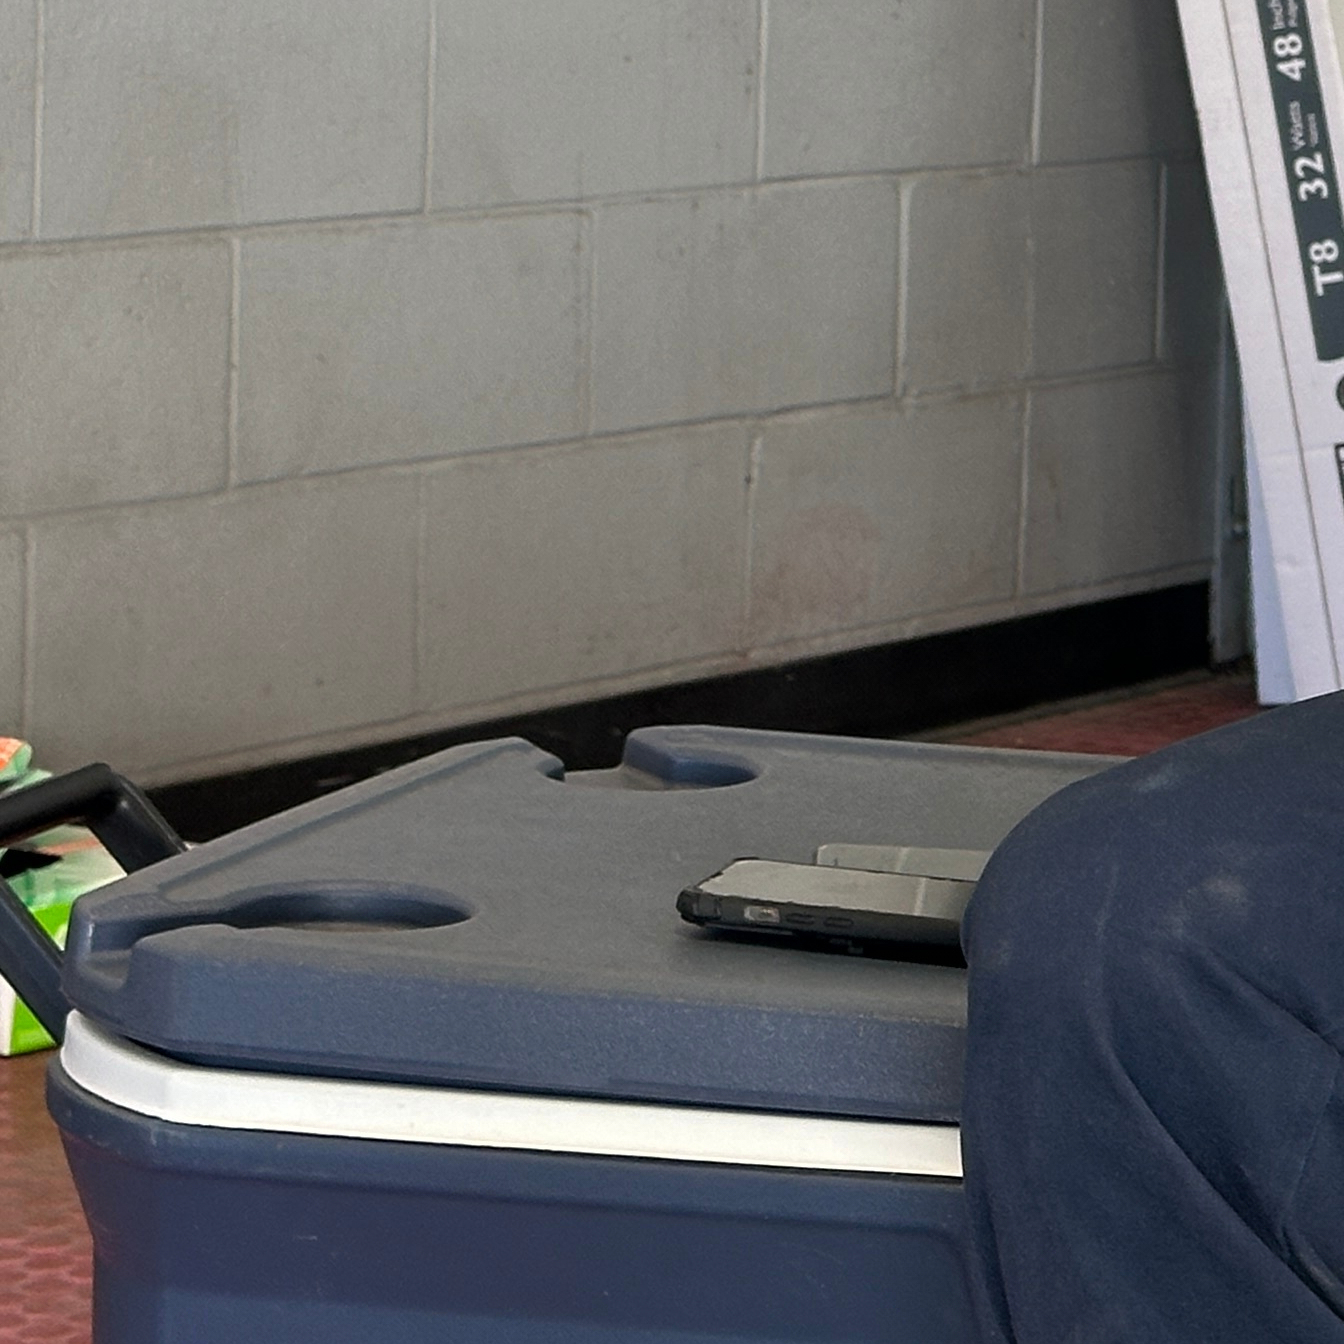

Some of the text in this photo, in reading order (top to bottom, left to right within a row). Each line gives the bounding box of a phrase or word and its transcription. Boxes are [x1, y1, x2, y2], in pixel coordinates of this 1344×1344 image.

[1272, 32, 1307, 81] 48
[1294, 152, 1329, 201] 32
[1309, 237, 1344, 296] T8
